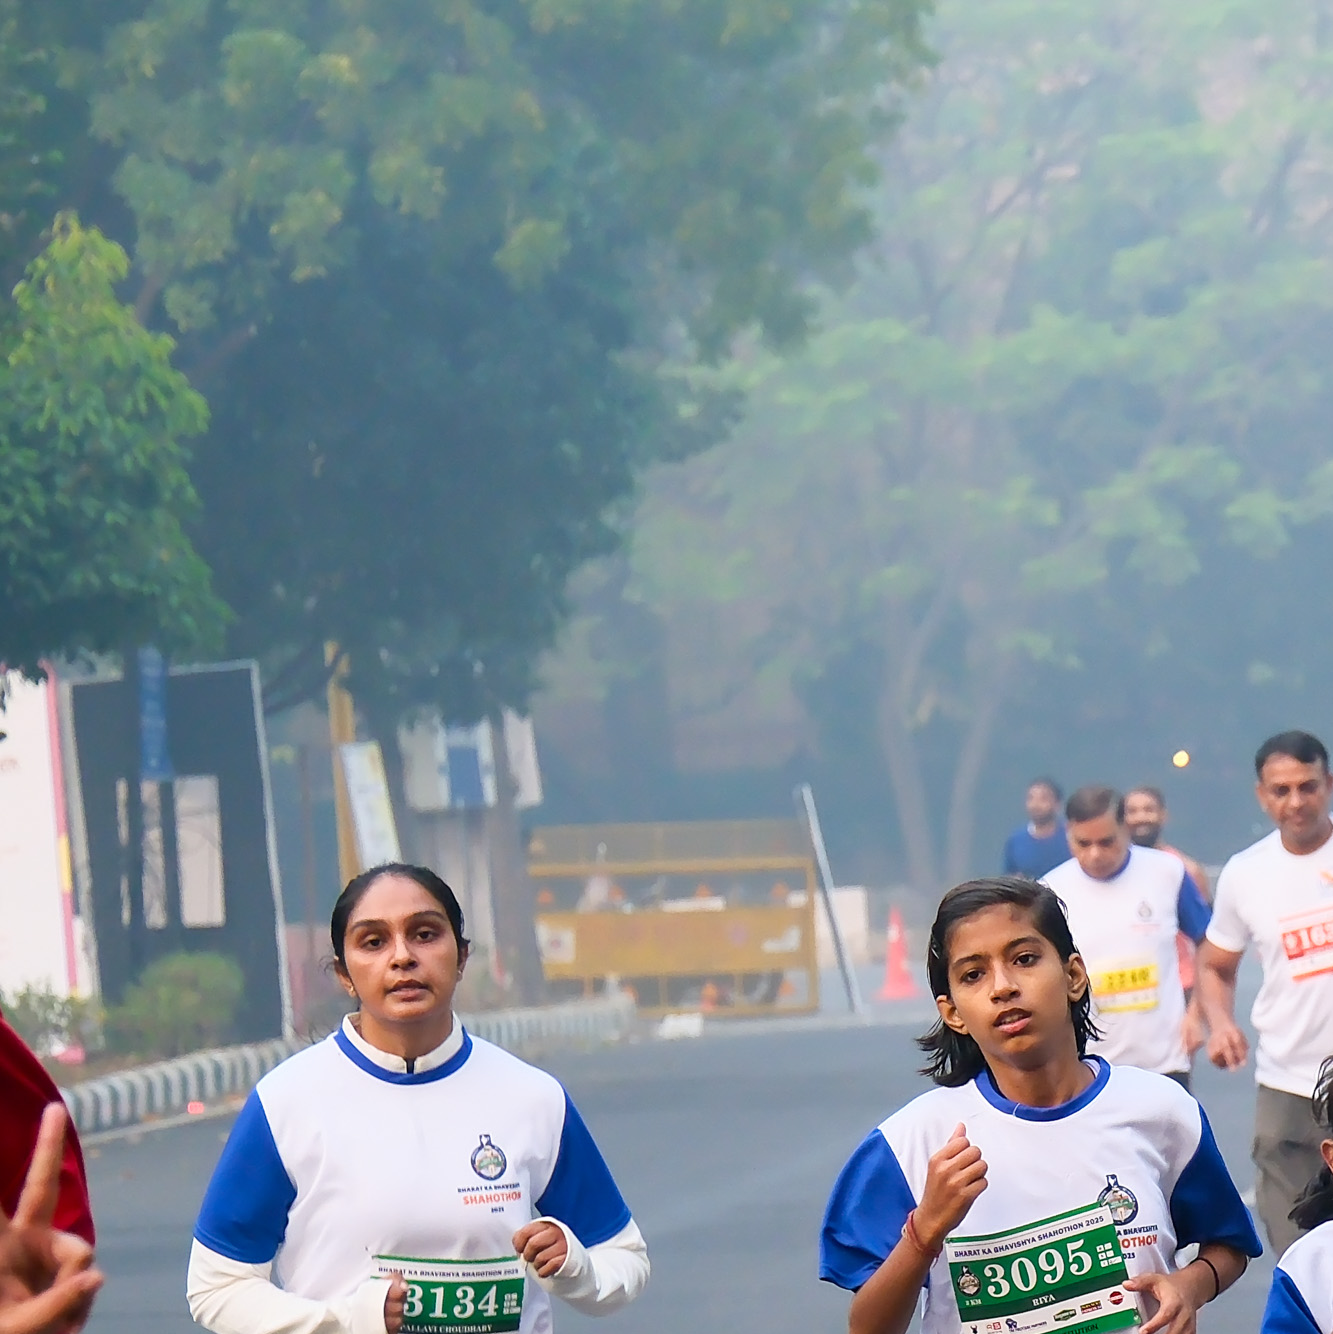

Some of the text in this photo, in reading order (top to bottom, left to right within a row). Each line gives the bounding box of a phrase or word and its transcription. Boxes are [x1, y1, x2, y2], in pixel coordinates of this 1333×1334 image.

[953, 1248, 981, 1258] BHARAT
[982, 1246, 993, 1255] KA
[993, 1237, 1036, 1253] BHAVISHYA
[1085, 1215, 1105, 1227] 2025
[1117, 1234, 1158, 1249] OTHON
[983, 1238, 1093, 1298] 3095
[403, 1284, 499, 1319] 3134
[1032, 1294, 1056, 1307] RIYA
